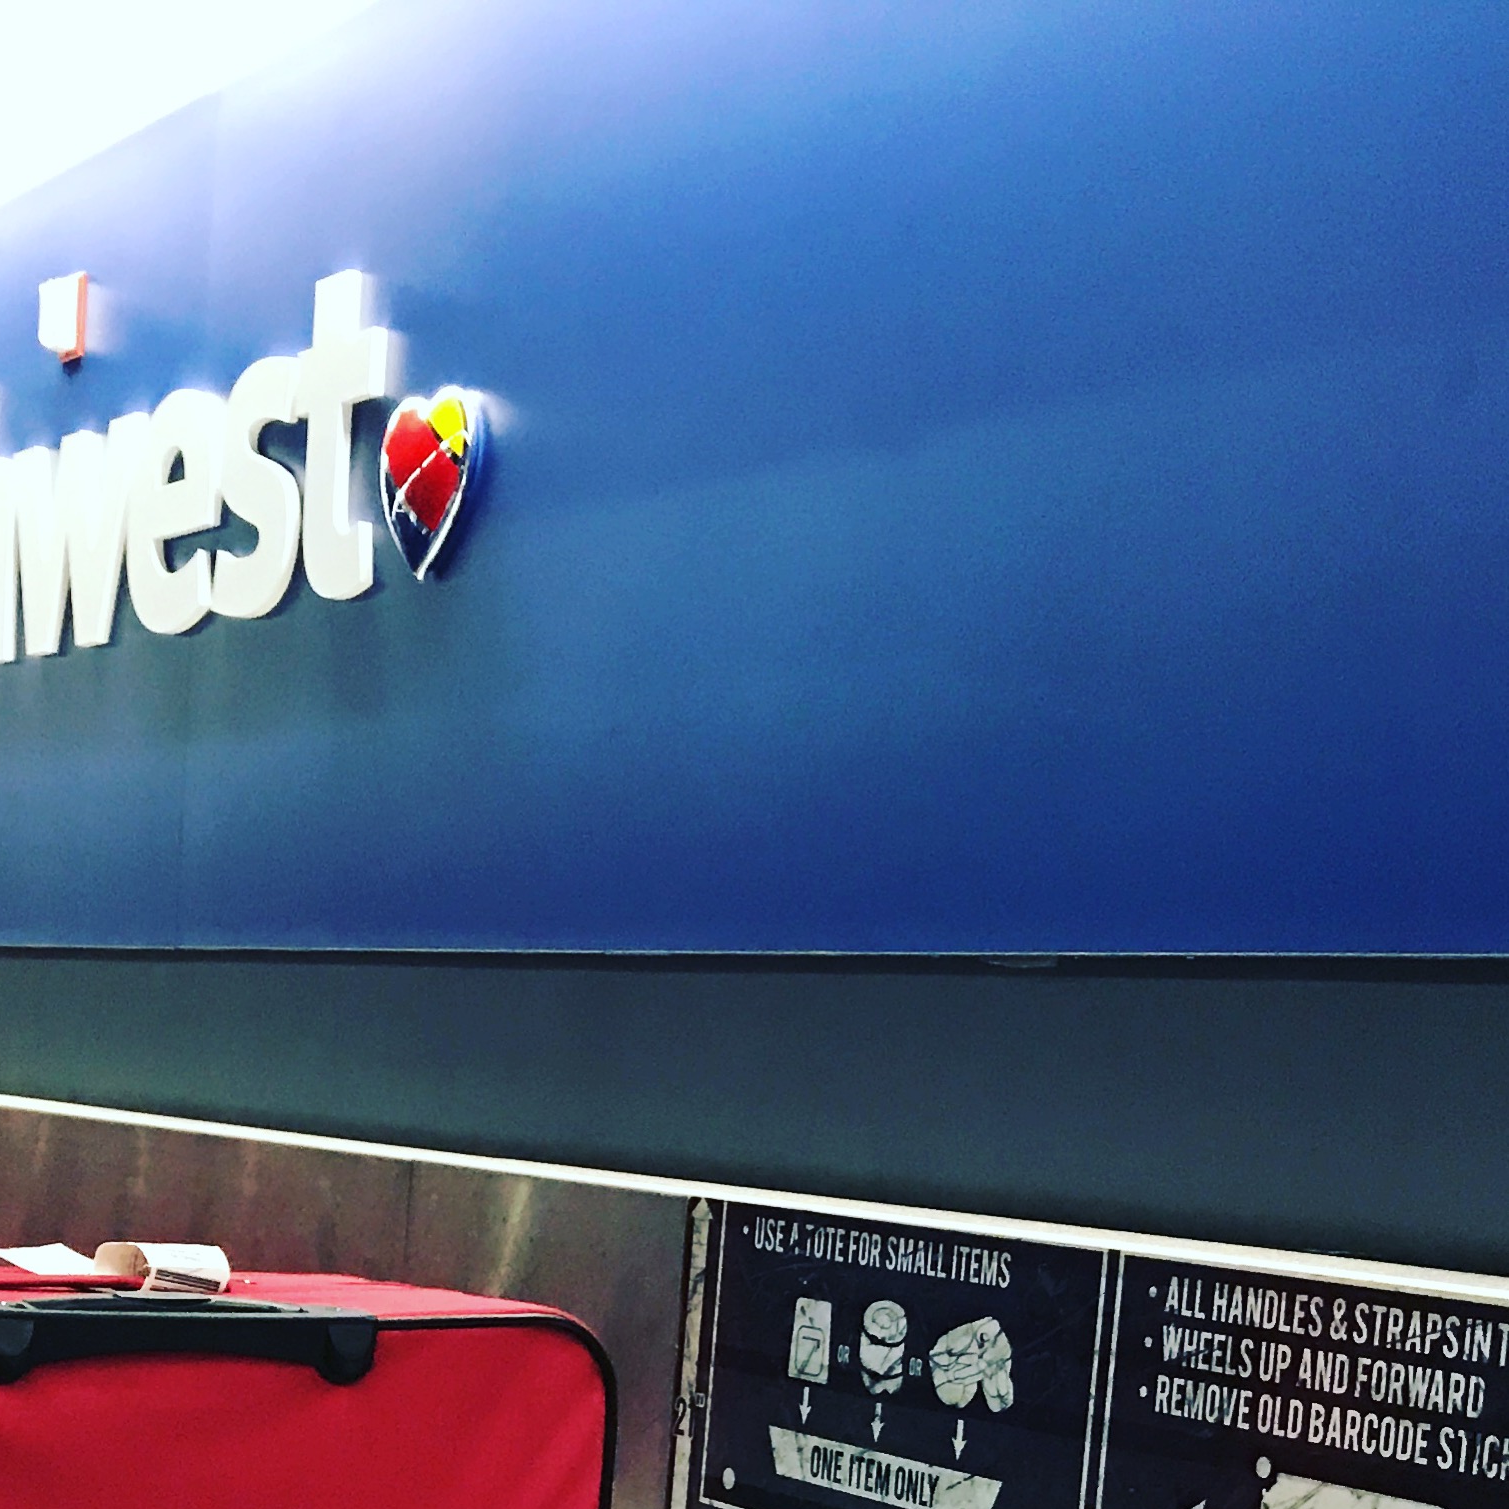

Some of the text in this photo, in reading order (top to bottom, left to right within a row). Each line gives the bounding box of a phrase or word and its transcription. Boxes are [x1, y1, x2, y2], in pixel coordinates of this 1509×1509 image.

[754, 1216, 786, 1253] USE
[848, 1231, 881, 1268] FOR
[885, 1236, 947, 1279] SMALL
[951, 1245, 1012, 1289] ITEMS
[1164, 1276, 1206, 1320] ALL
[1212, 1282, 1324, 1337] HANDLES
[1330, 1298, 1349, 1341] &
[1352, 1303, 1461, 1359] STRAPS
[1462, 1318, 1493, 1364] IN
[1162, 1323, 1486, 1419] WHEELS UP AND FORWARD
[1154, 1375, 1254, 1430] REMOVE
[1257, 1394, 1304, 1440] OLD
[1307, 1403, 1432, 1466] BARCODE
[809, 1445, 940, 1508] ONE ITEM ONLY
